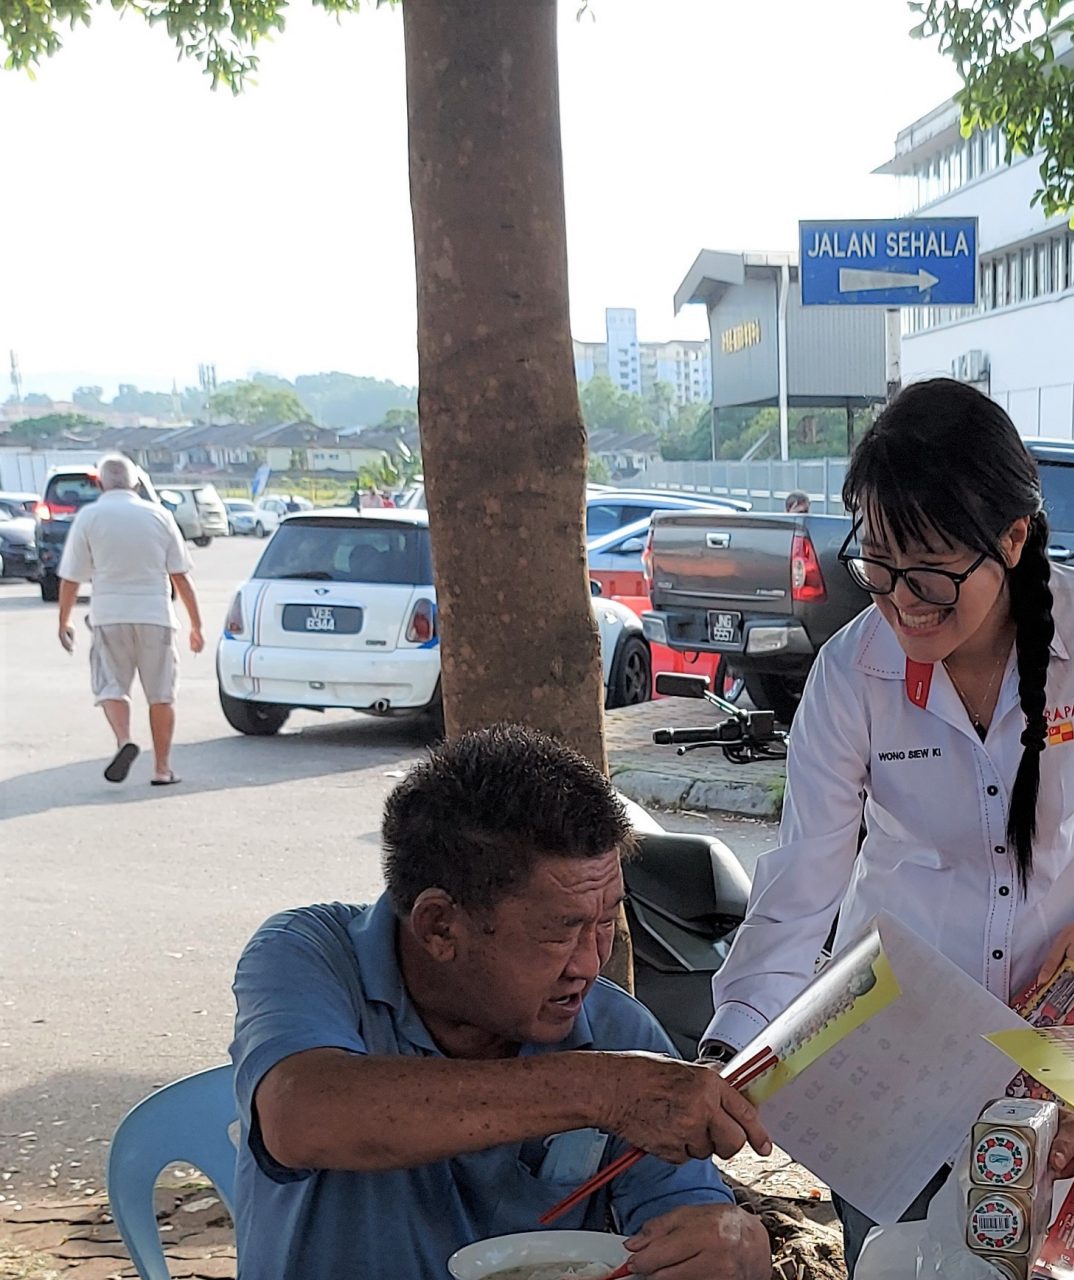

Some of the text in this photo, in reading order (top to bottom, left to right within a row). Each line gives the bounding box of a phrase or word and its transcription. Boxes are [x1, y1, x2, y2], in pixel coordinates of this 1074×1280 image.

[808, 230, 969, 258] JALAN SEHALA
[311, 606, 333, 618] VEE
[715, 614, 732, 628] JNG
[878, 748, 941, 762] WONG SIEW KI
